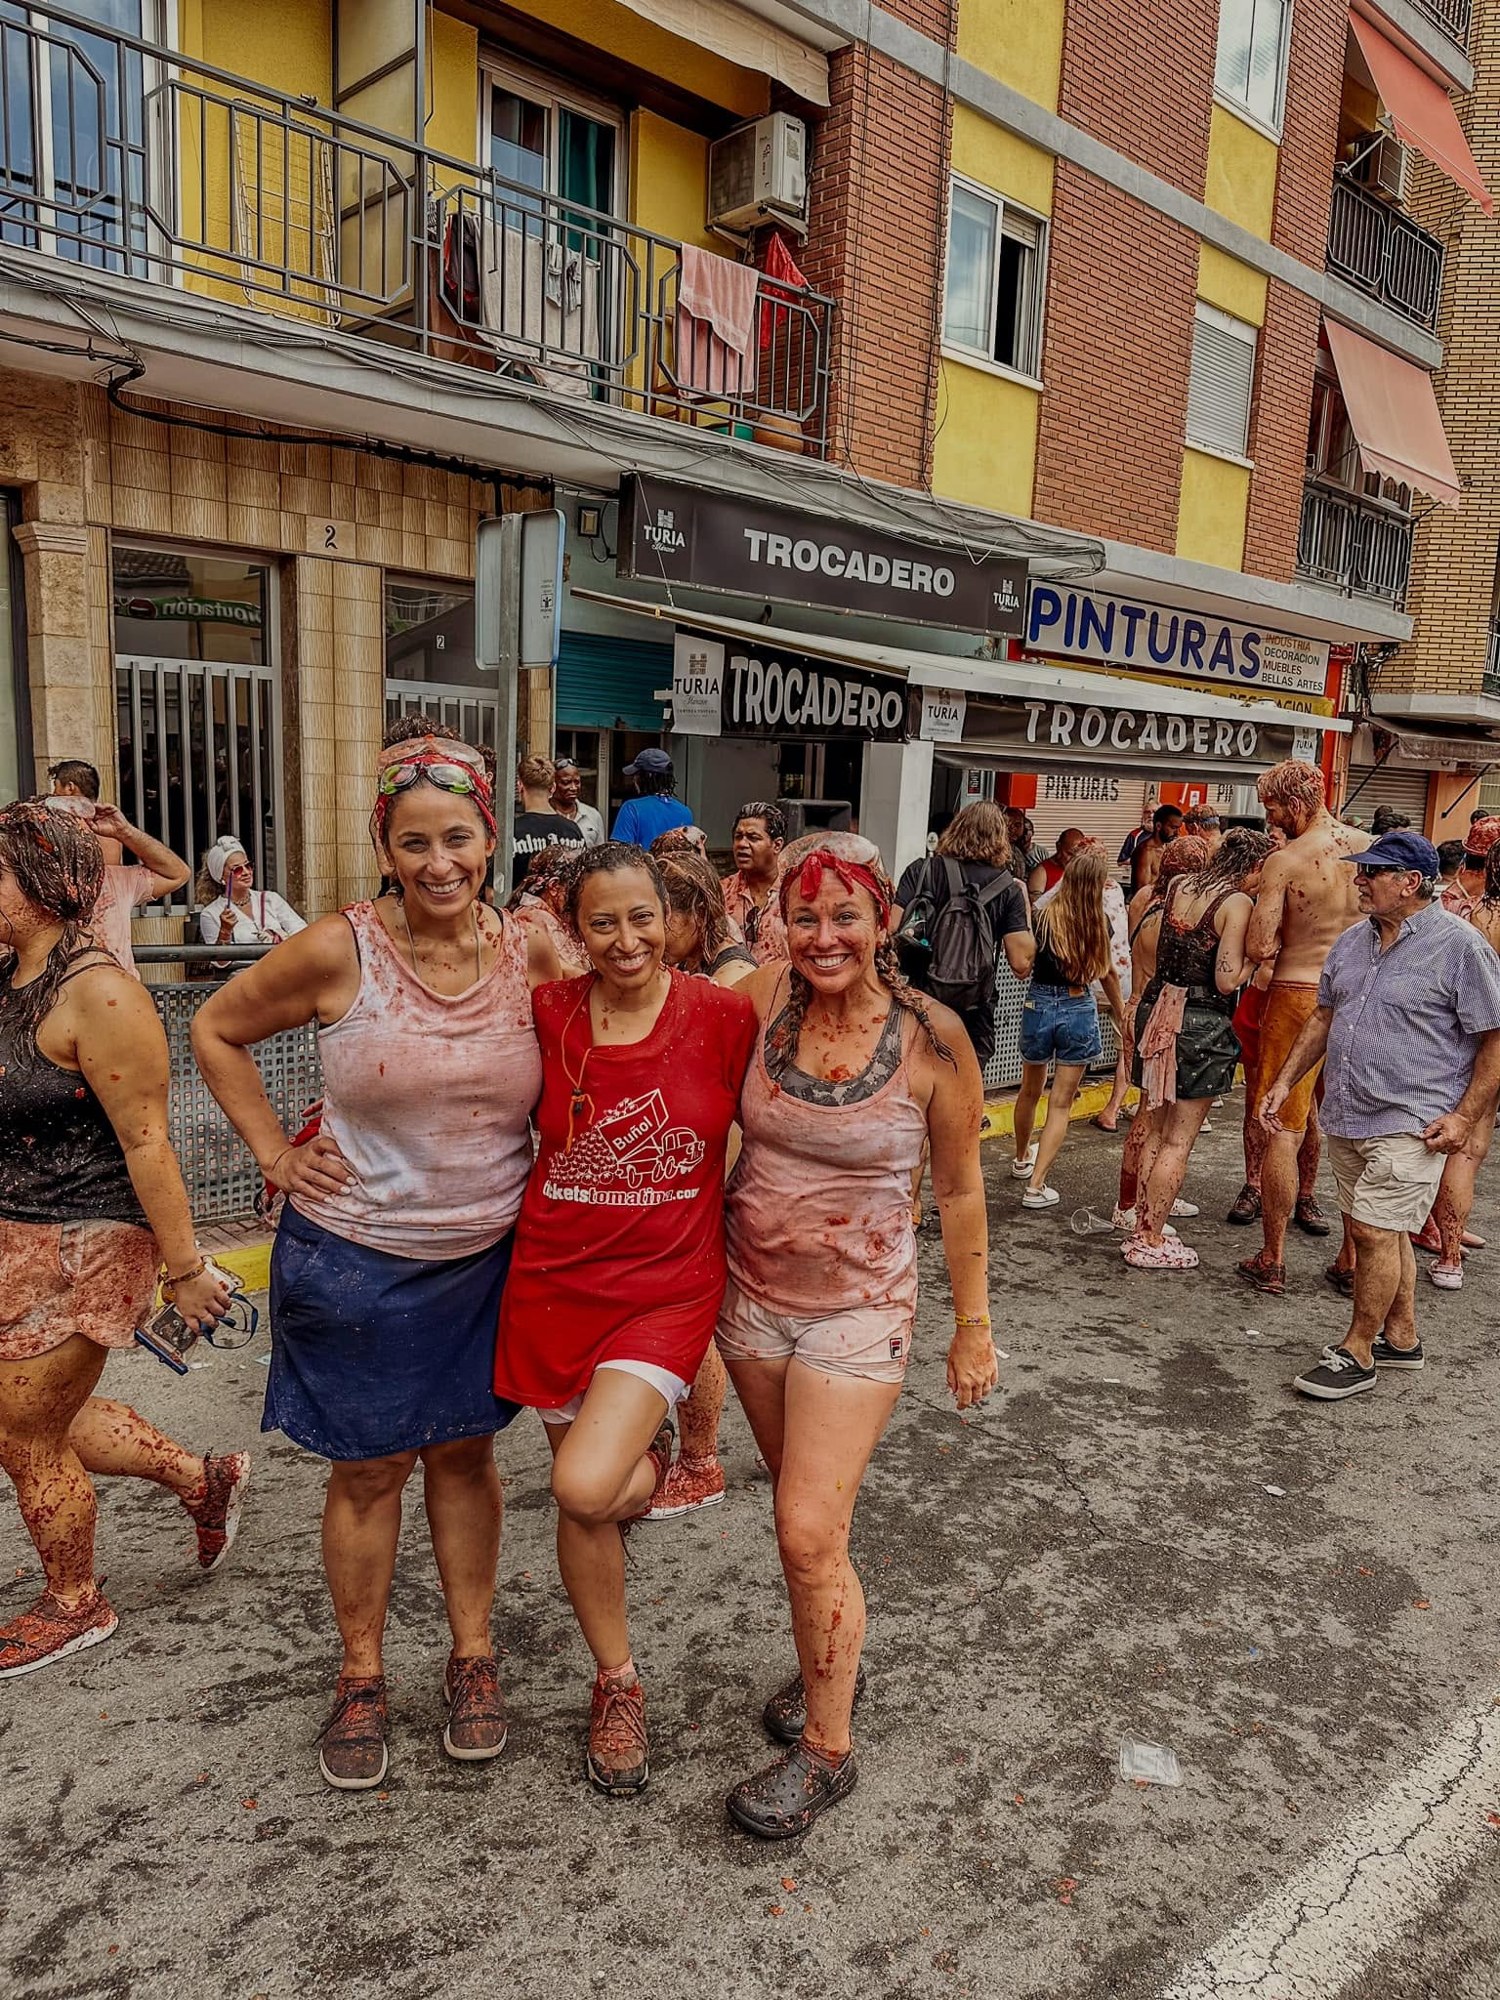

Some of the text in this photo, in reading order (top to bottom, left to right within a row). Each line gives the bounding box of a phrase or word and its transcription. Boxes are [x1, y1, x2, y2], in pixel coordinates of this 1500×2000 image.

[325, 525, 338, 550] 2
[643, 525, 686, 547] TURIA
[743, 528, 955, 597] TROCADERO
[993, 592, 1020, 608] TURIA
[437, 635, 445, 649] 2
[1029, 587, 1261, 679] PINTURAS
[1265, 633, 1311, 651] INDUSTRIA
[1264, 646, 1320, 666] DECORACION
[1262, 660, 1303, 675] MUEBLES
[674, 678, 720, 695] TURIA
[730, 656, 903, 729] TROCADERO
[1261, 672, 1324, 692] BELLAS ARTES
[927, 705, 959, 721] TURIA
[1024, 702, 1258, 757] TROCADERO
[1044, 776, 1119, 801] PINTURAS
[612, 1115, 653, 1150] Buñol
